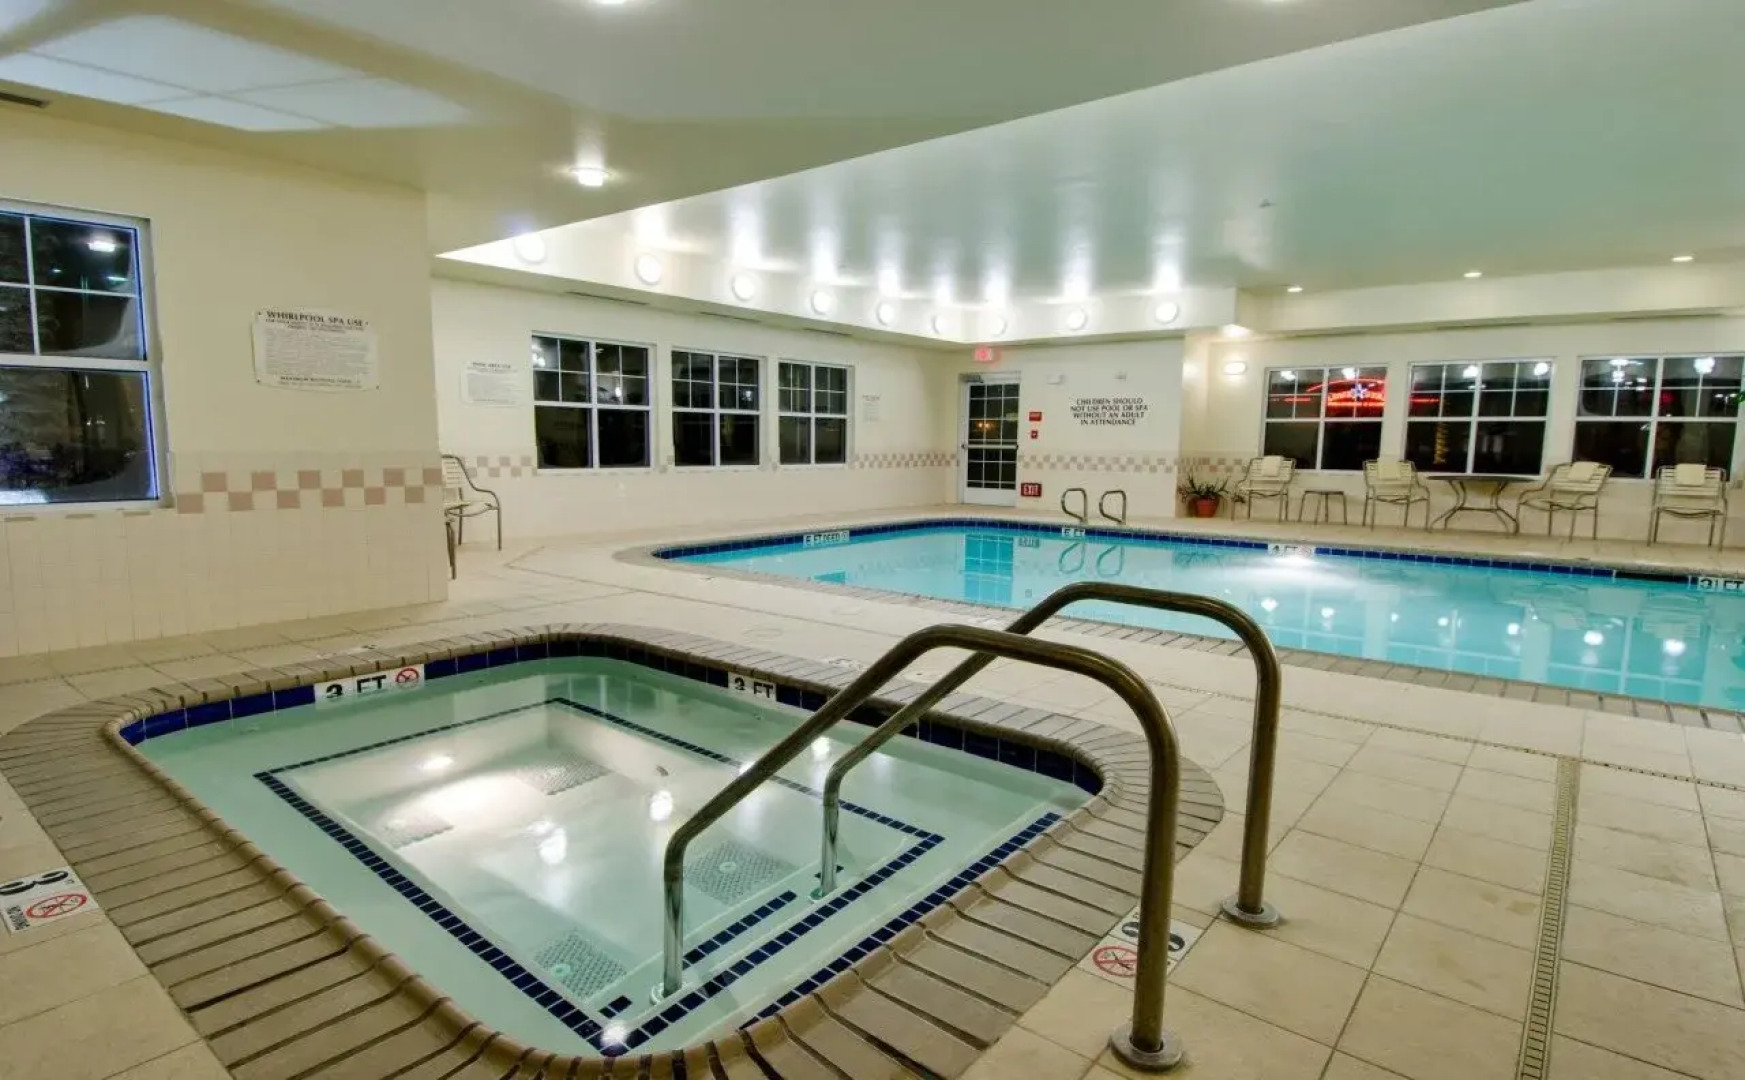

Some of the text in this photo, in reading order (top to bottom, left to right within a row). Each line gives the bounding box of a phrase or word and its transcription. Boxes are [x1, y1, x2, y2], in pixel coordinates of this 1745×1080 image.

[266, 310, 324, 322] WHIRLPOOL
[328, 315, 345, 325] SPA
[347, 317, 363, 327] USE
[1076, 397, 1144, 405] CHILDREN SHOULD
[1023, 484, 1040, 496] EXIT
[356, 675, 387, 693] FT
[753, 681, 774, 698] FT
